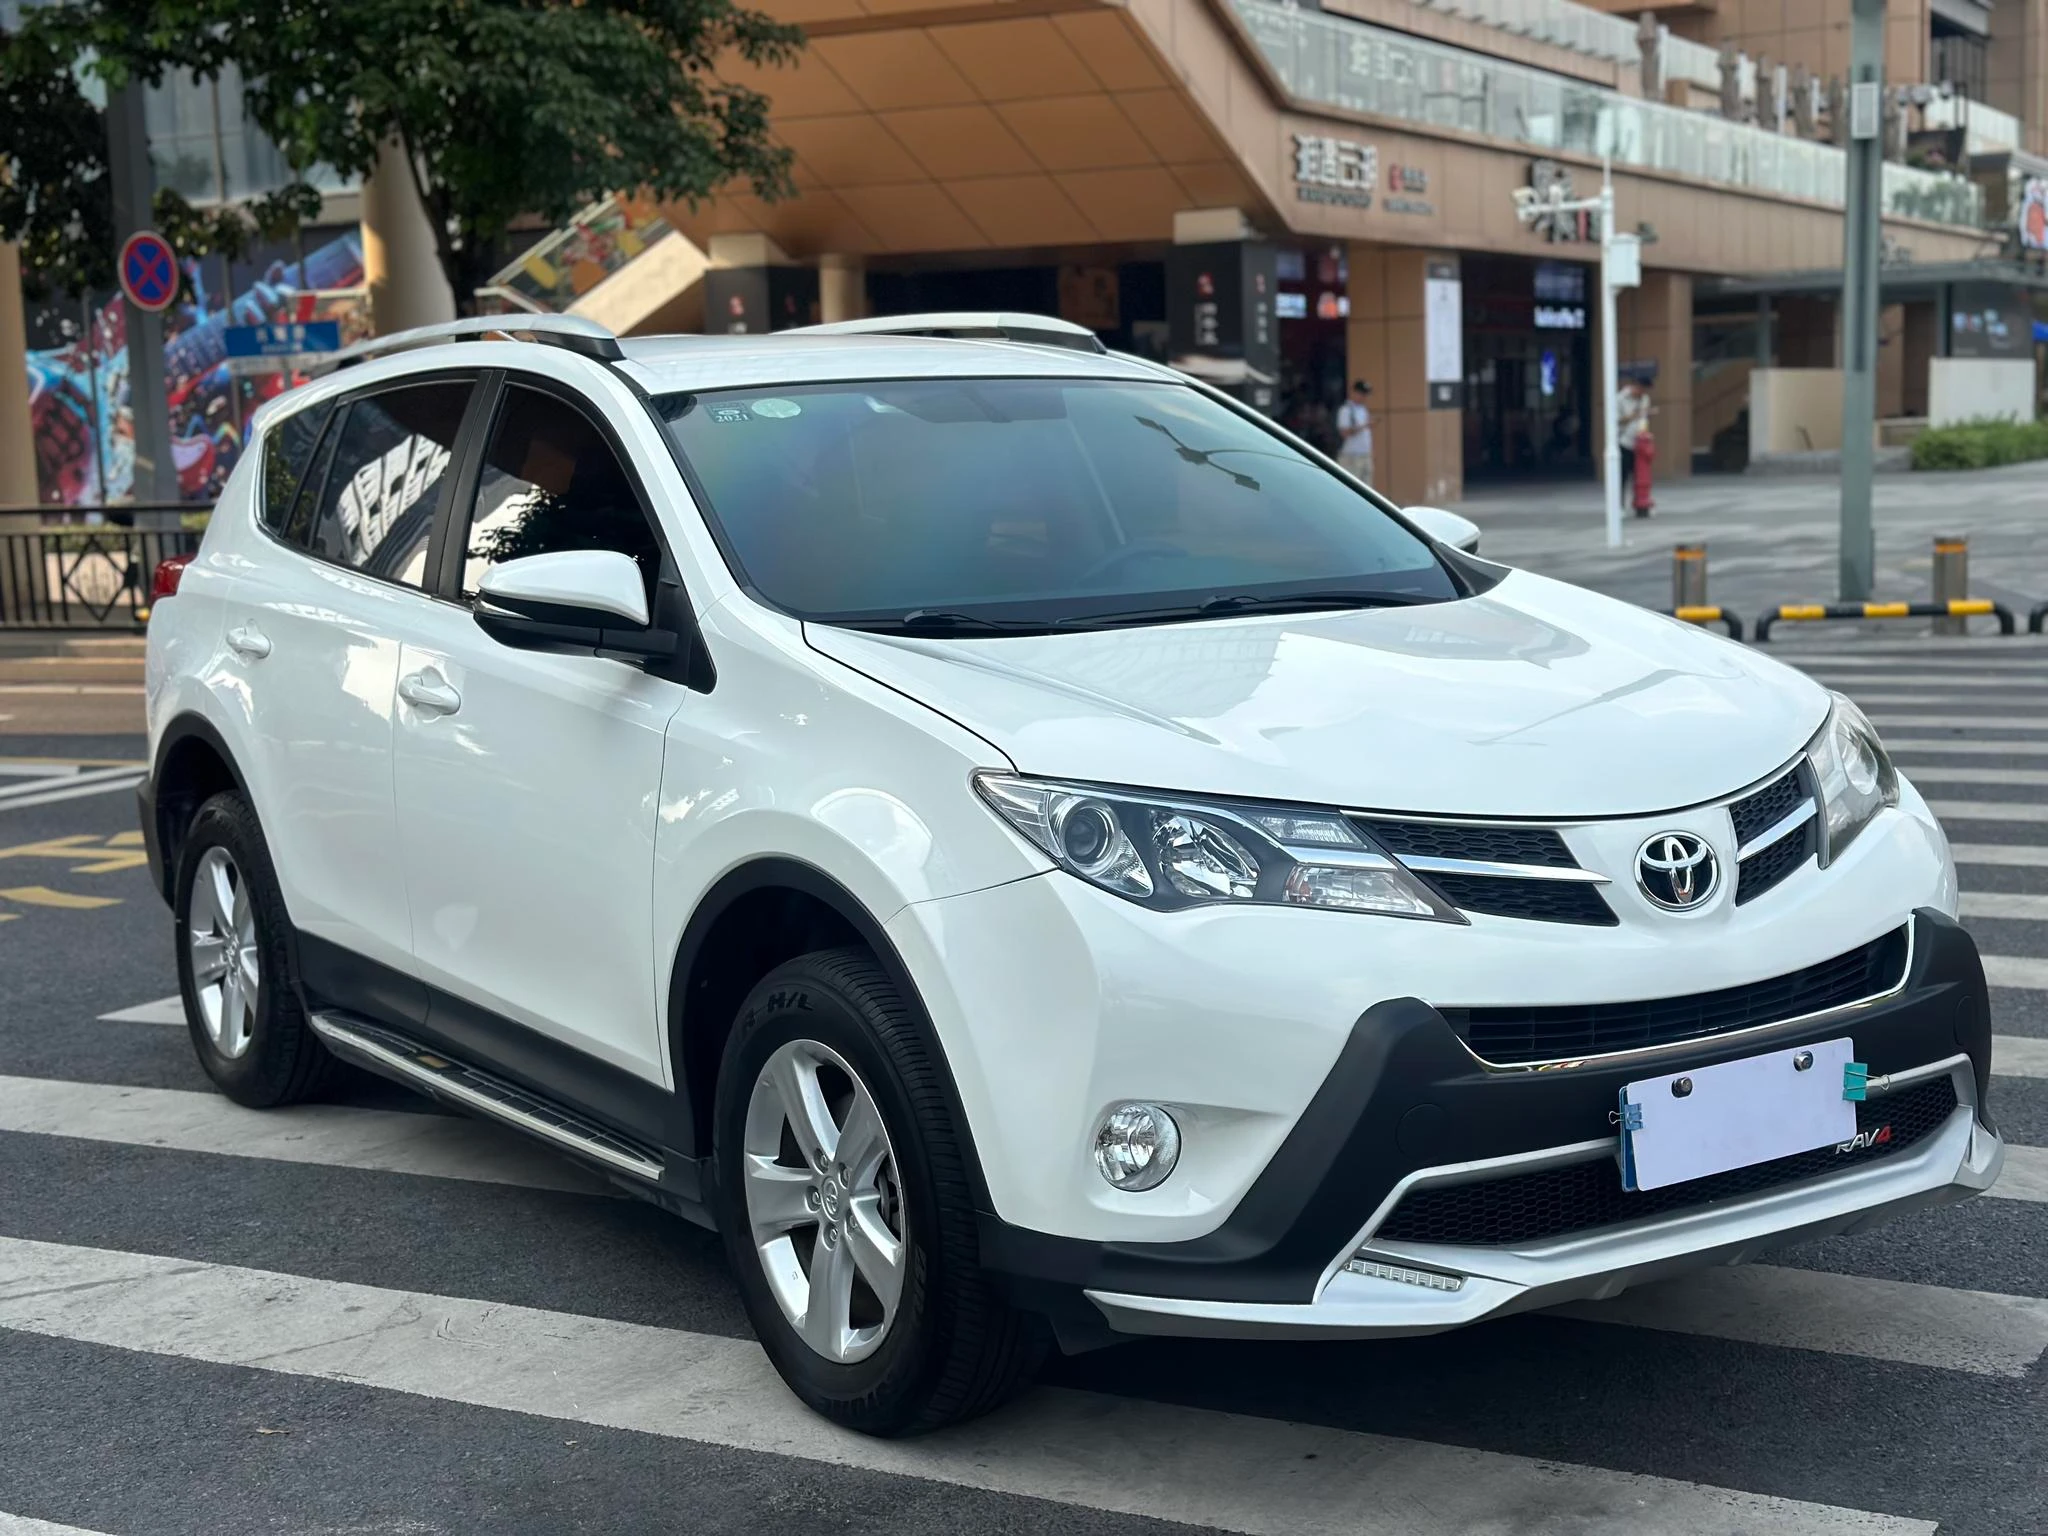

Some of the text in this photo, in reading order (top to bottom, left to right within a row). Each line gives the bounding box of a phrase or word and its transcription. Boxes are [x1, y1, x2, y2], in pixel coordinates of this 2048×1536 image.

[714, 413, 750, 423] 2021
[767, 991, 814, 1013] H/L
[1835, 1125, 1891, 1155] RAV4
